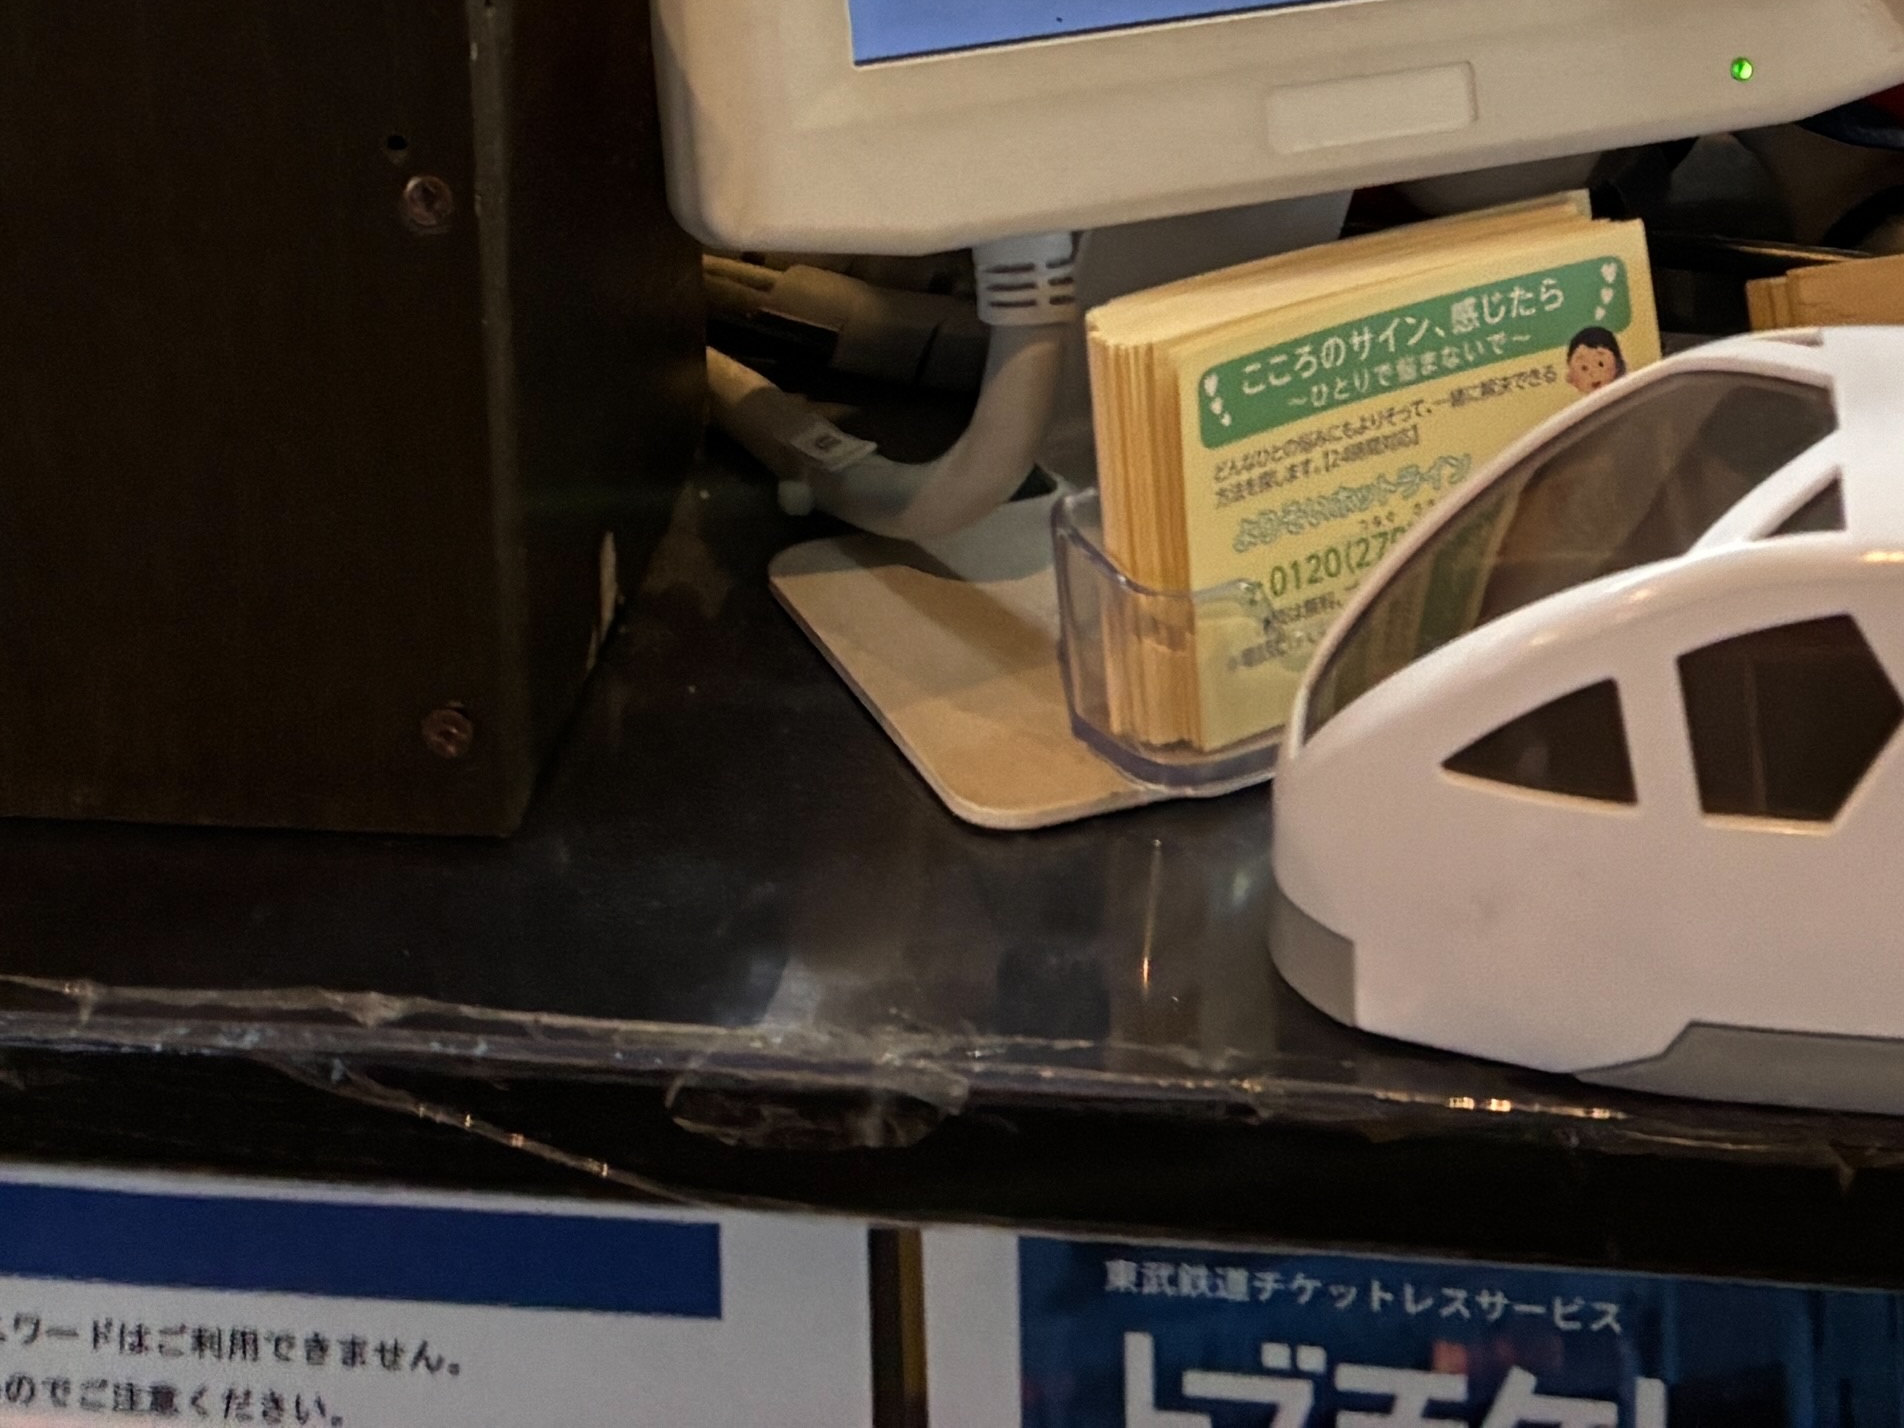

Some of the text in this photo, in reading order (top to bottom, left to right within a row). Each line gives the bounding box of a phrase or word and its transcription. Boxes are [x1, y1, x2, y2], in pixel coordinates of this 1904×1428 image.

[1239, 276, 1565, 396] こころのサイン、感じたら
[1103, 1257, 1624, 1334] 東武鉄道チケットレスサービス
